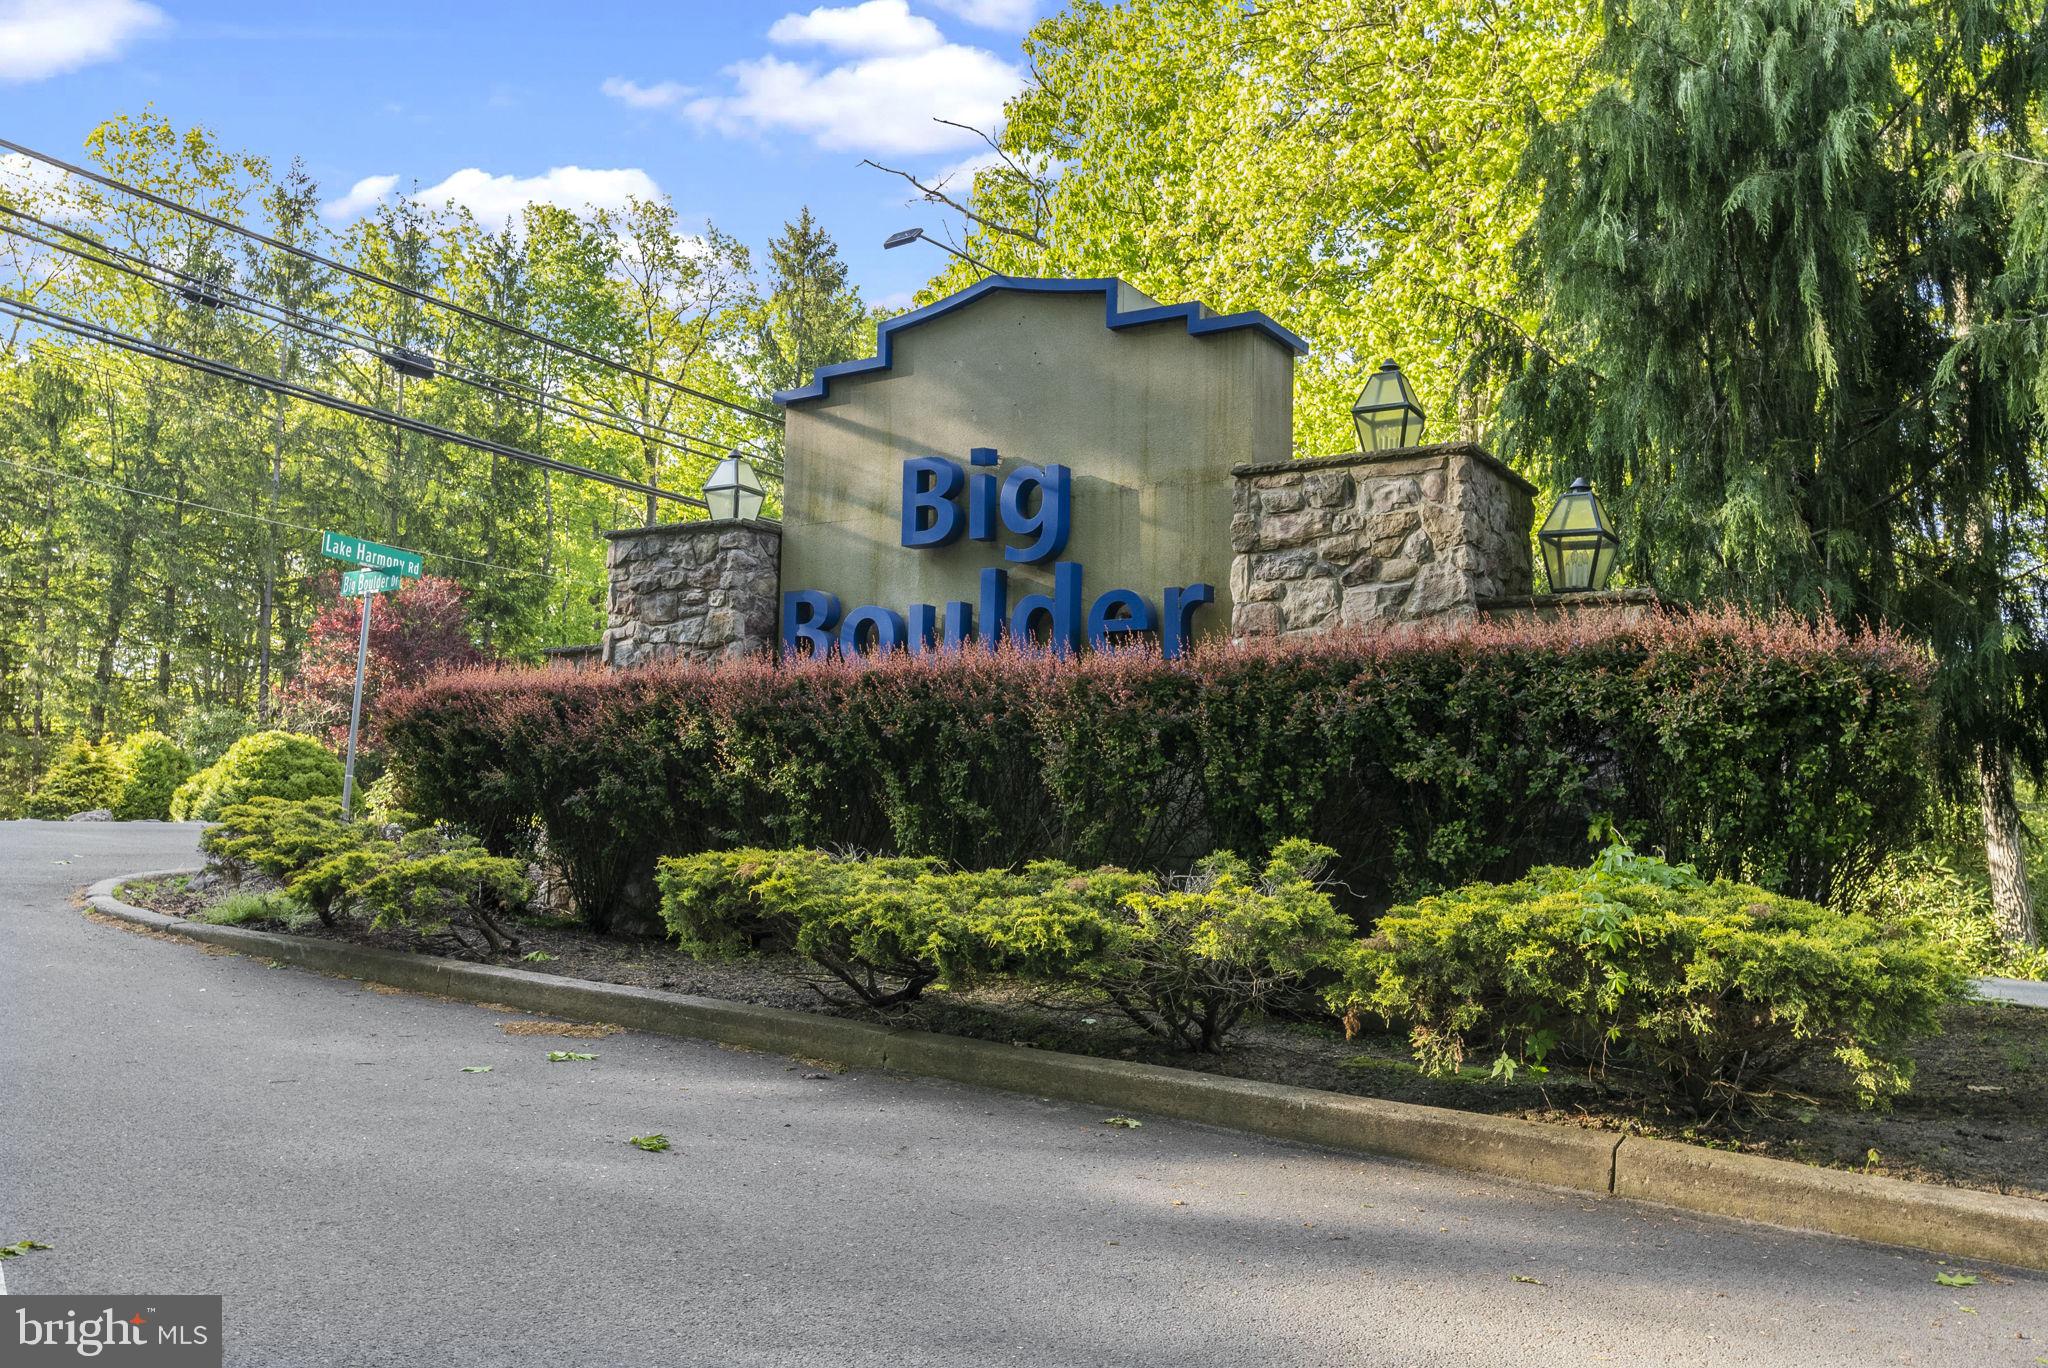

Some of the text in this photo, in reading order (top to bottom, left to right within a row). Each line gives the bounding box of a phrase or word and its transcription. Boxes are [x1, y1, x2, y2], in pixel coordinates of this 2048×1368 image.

[901, 447, 1071, 565] Big
[325, 534, 420, 575] Lake Harmony Rd
[343, 573, 399, 594] Big Boulder Dr
[783, 562, 1214, 661] Boulder
